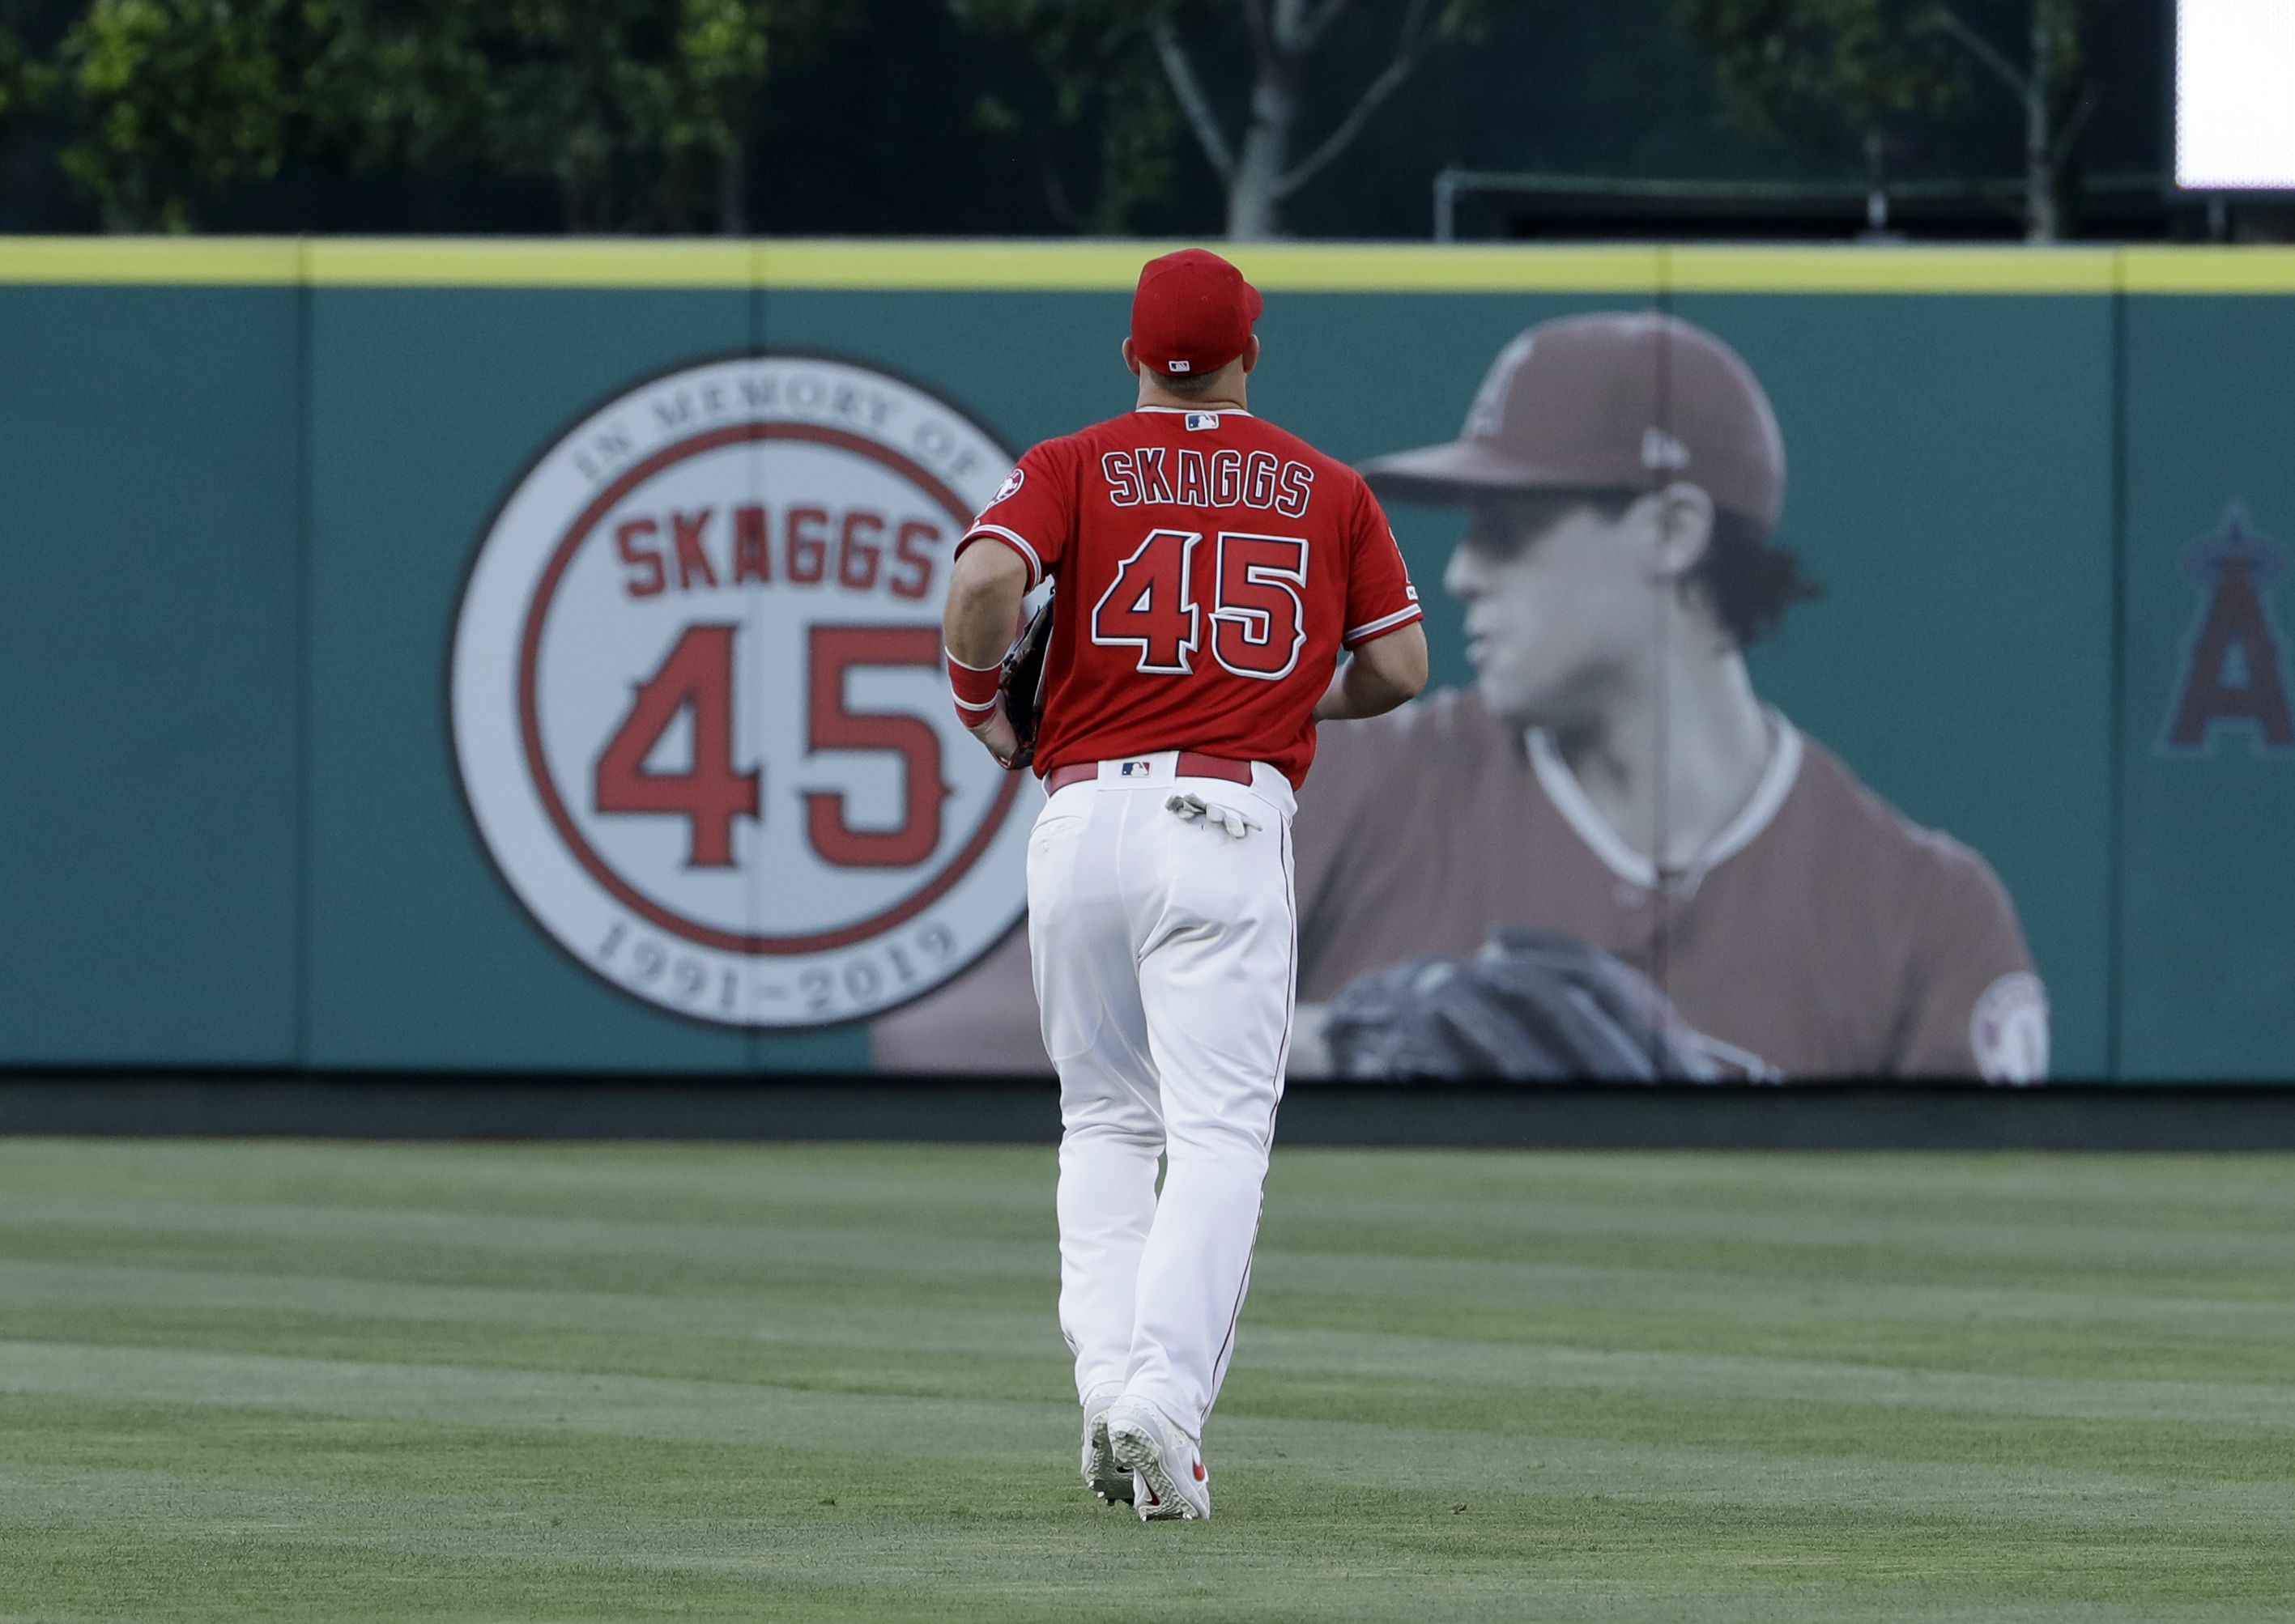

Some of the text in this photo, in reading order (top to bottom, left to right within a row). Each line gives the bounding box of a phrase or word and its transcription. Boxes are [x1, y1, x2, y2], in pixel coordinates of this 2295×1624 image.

[570, 369, 986, 483] IN MEMORY OF
[1101, 447, 1314, 519] SKAGGS
[614, 504, 943, 601] SKAGGS
[1092, 528, 1309, 681] 45
[593, 623, 952, 871] 45
